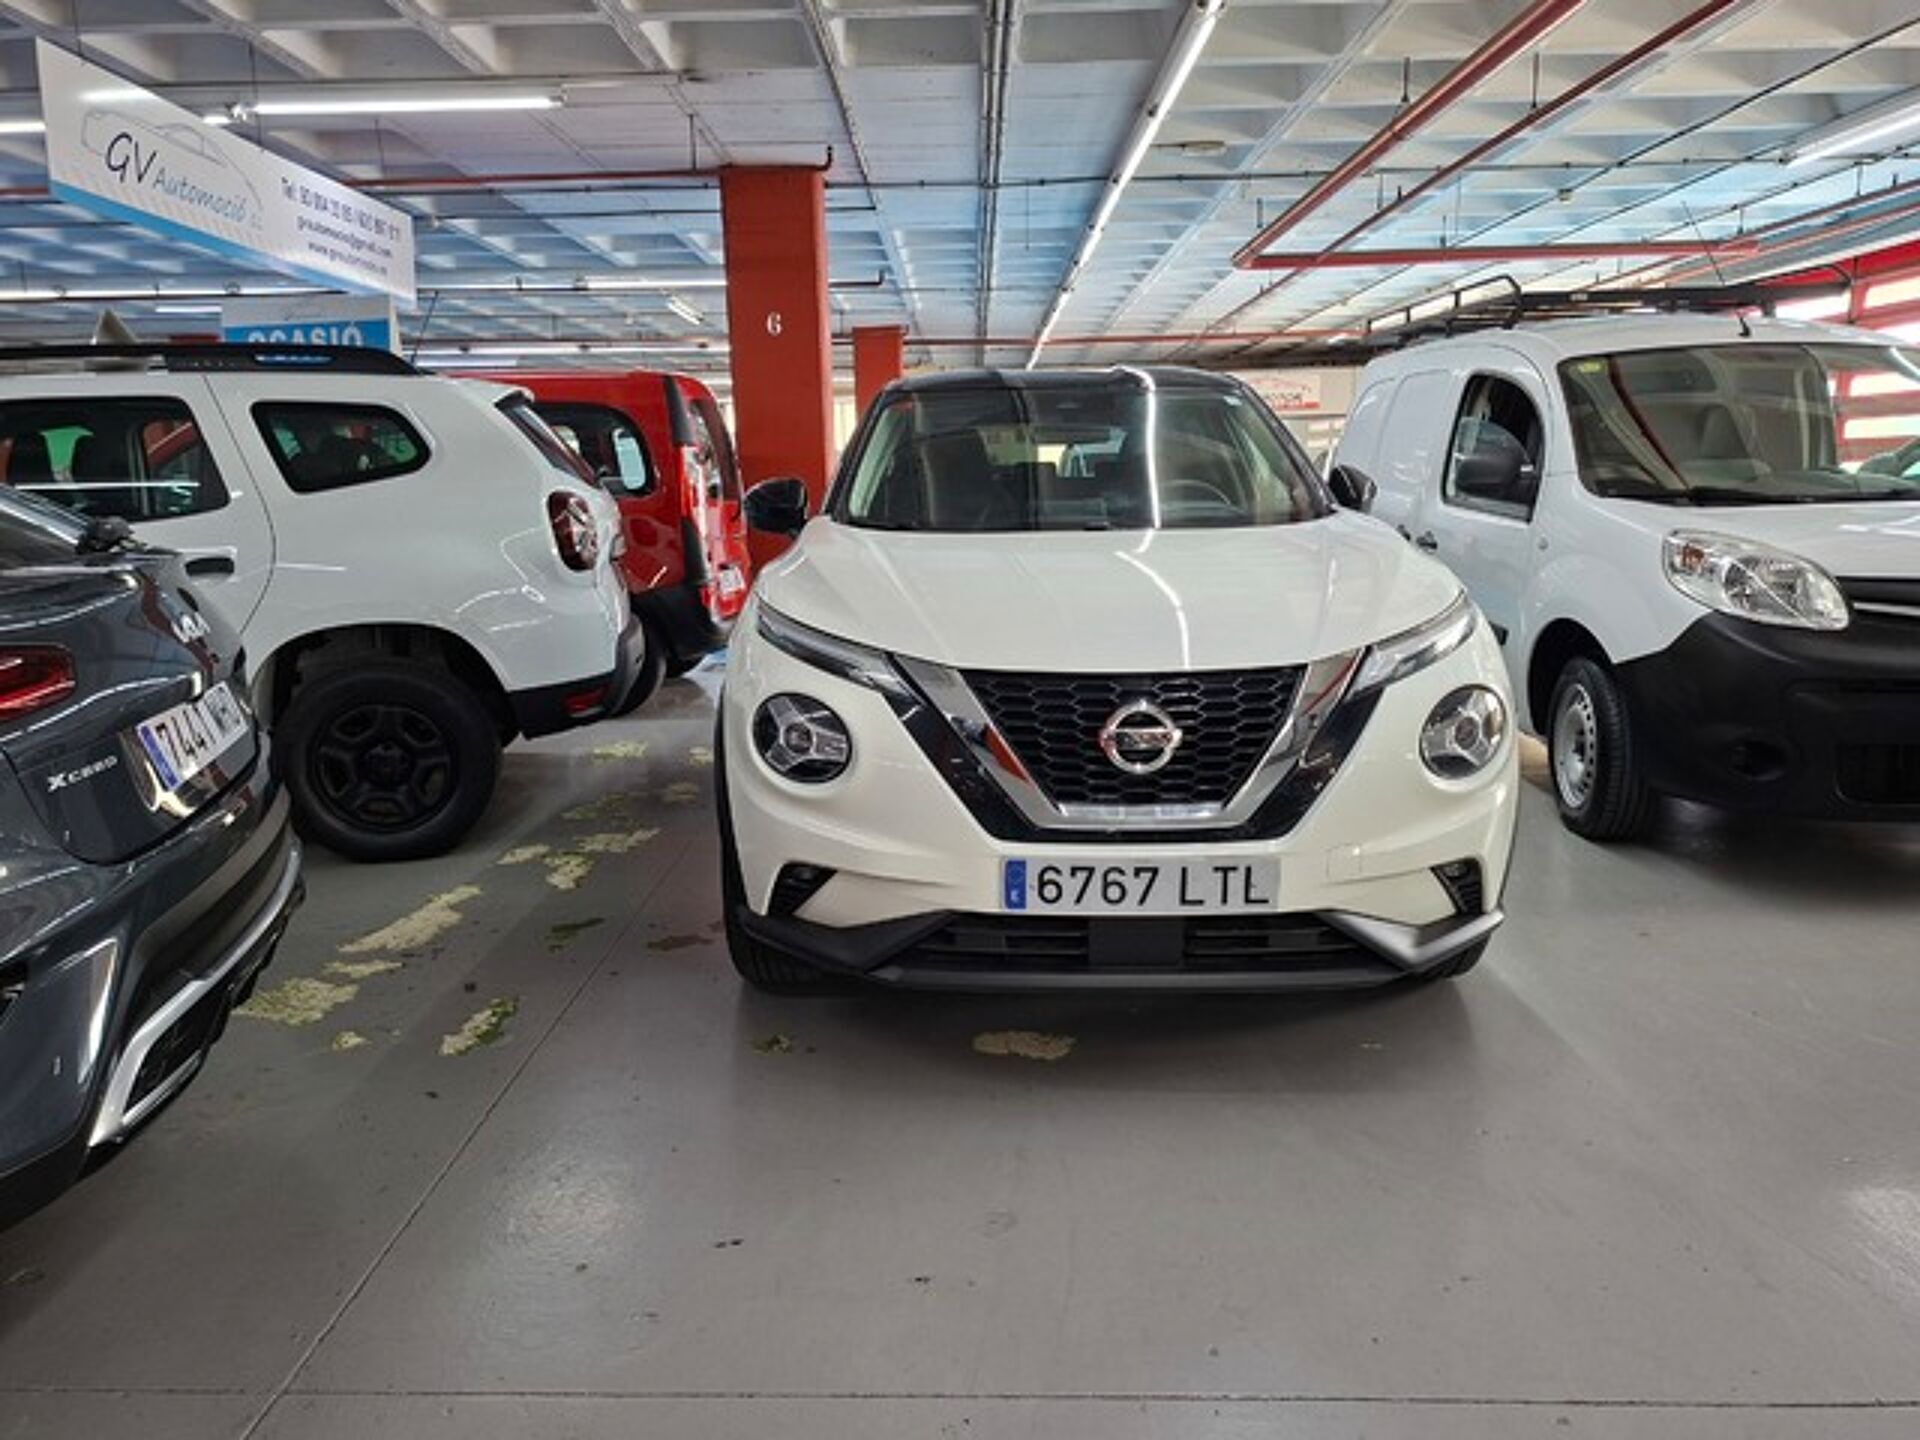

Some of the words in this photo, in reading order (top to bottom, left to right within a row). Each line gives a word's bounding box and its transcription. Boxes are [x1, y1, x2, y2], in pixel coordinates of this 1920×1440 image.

[105, 131, 158, 184] GV
[767, 311, 782, 337] 6
[154, 701, 217, 773] 7441
[1036, 865, 1160, 906] 6767
[1178, 864, 1270, 906] LTL
